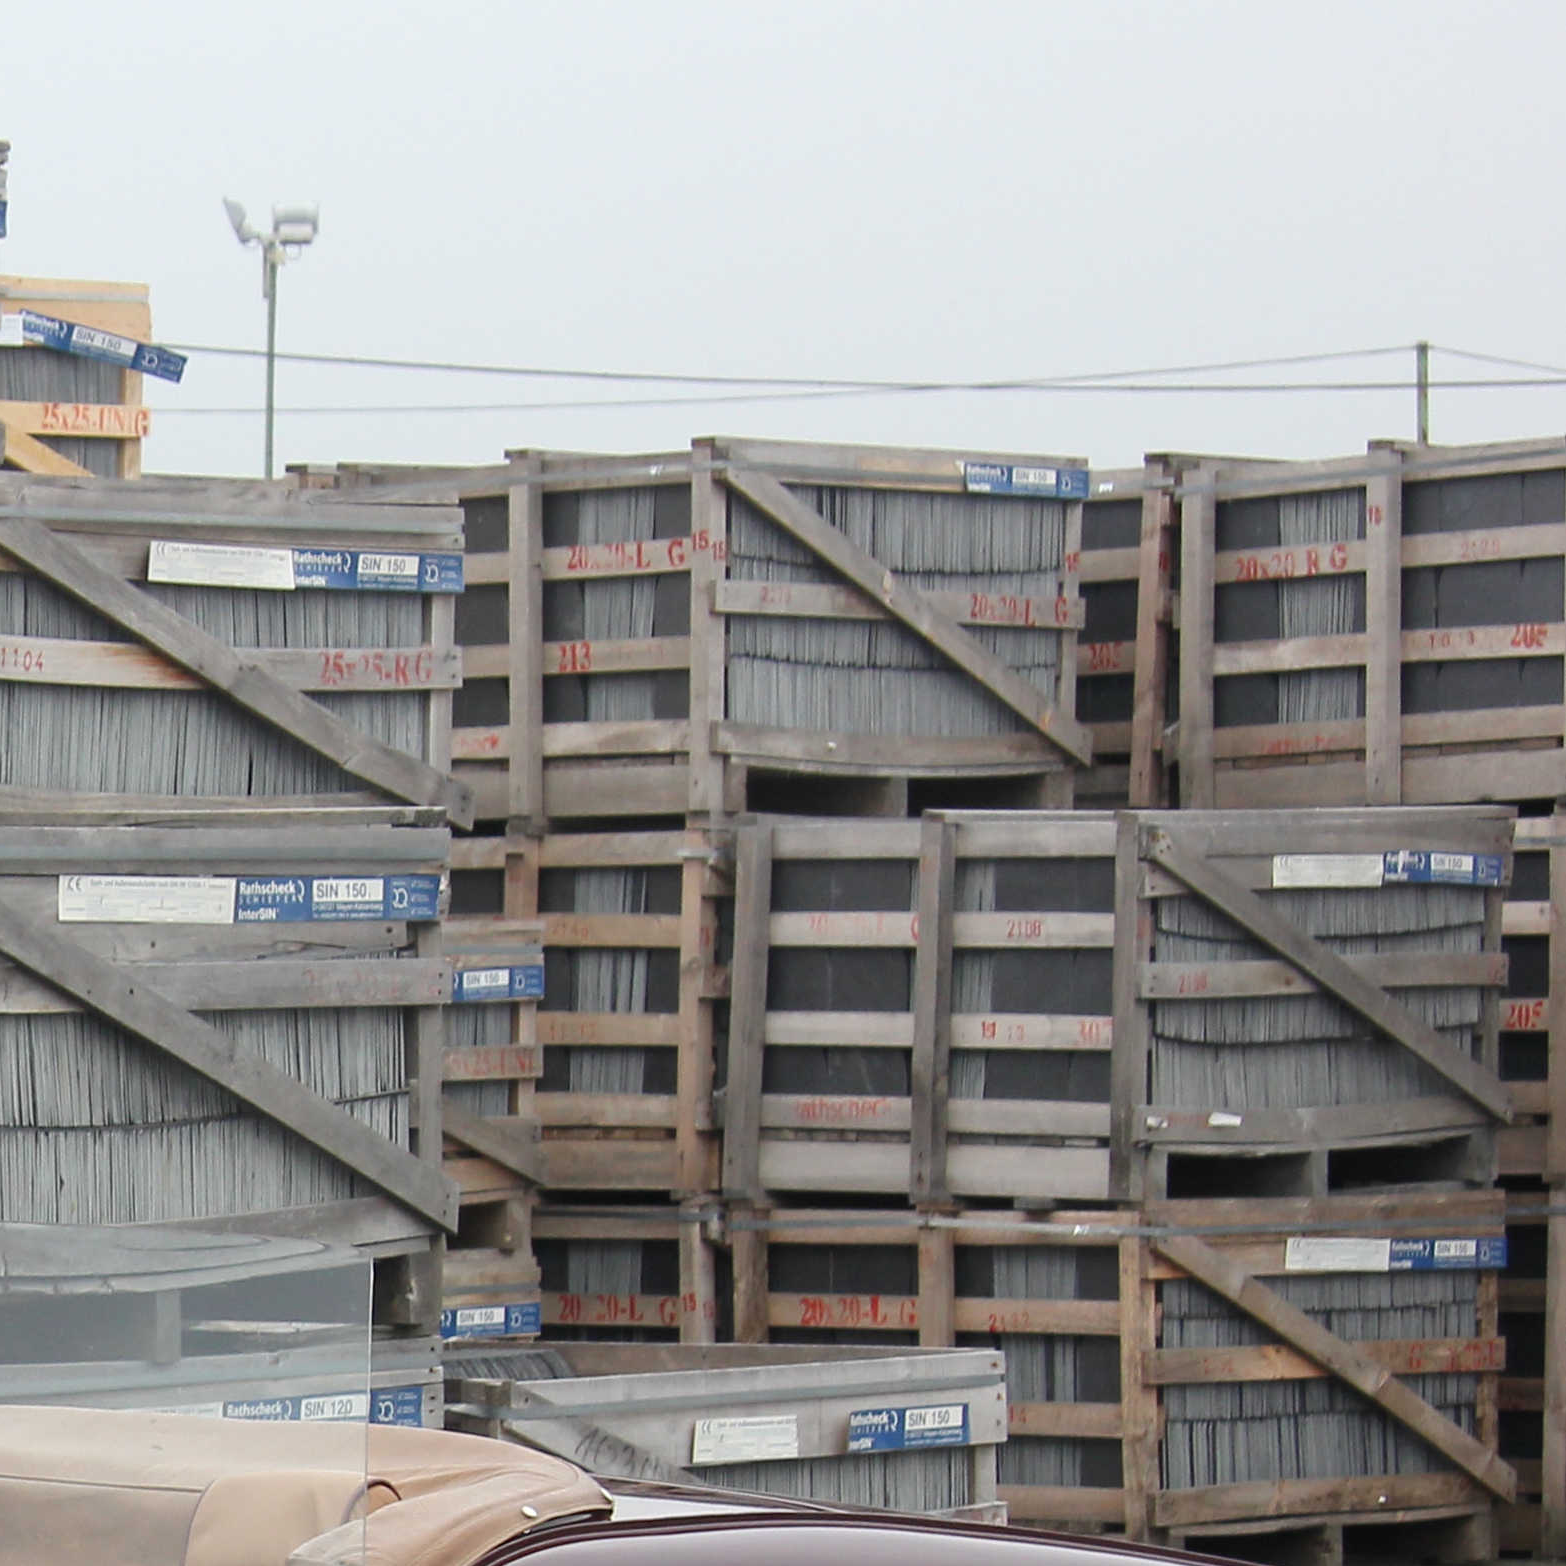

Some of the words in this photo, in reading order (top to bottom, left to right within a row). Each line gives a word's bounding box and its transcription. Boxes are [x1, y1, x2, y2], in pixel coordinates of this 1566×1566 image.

[75, 327, 96, 343] SIN
[101, 335, 122, 350] 150
[294, 551, 343, 565] Rathscheck
[667, 536, 686, 566] G
[360, 557, 382, 572] SIN
[386, 558, 407, 573] 150
[0, 647, 45, 672] 1104
[239, 880, 296, 897] Rathscheck
[317, 882, 339, 899] SIN
[345, 883, 368, 899] 150
[238, 908, 277, 921] InterSIN
[458, 1309, 475, 1324] SIN
[478, 1309, 495, 1323] 150
[227, 1401, 283, 1418] Rathscheck
[303, 1401, 325, 1418] SIN
[331, 1399, 353, 1417] 120
[907, 1412, 926, 1428] SIN
[930, 1409, 951, 1426] 150
